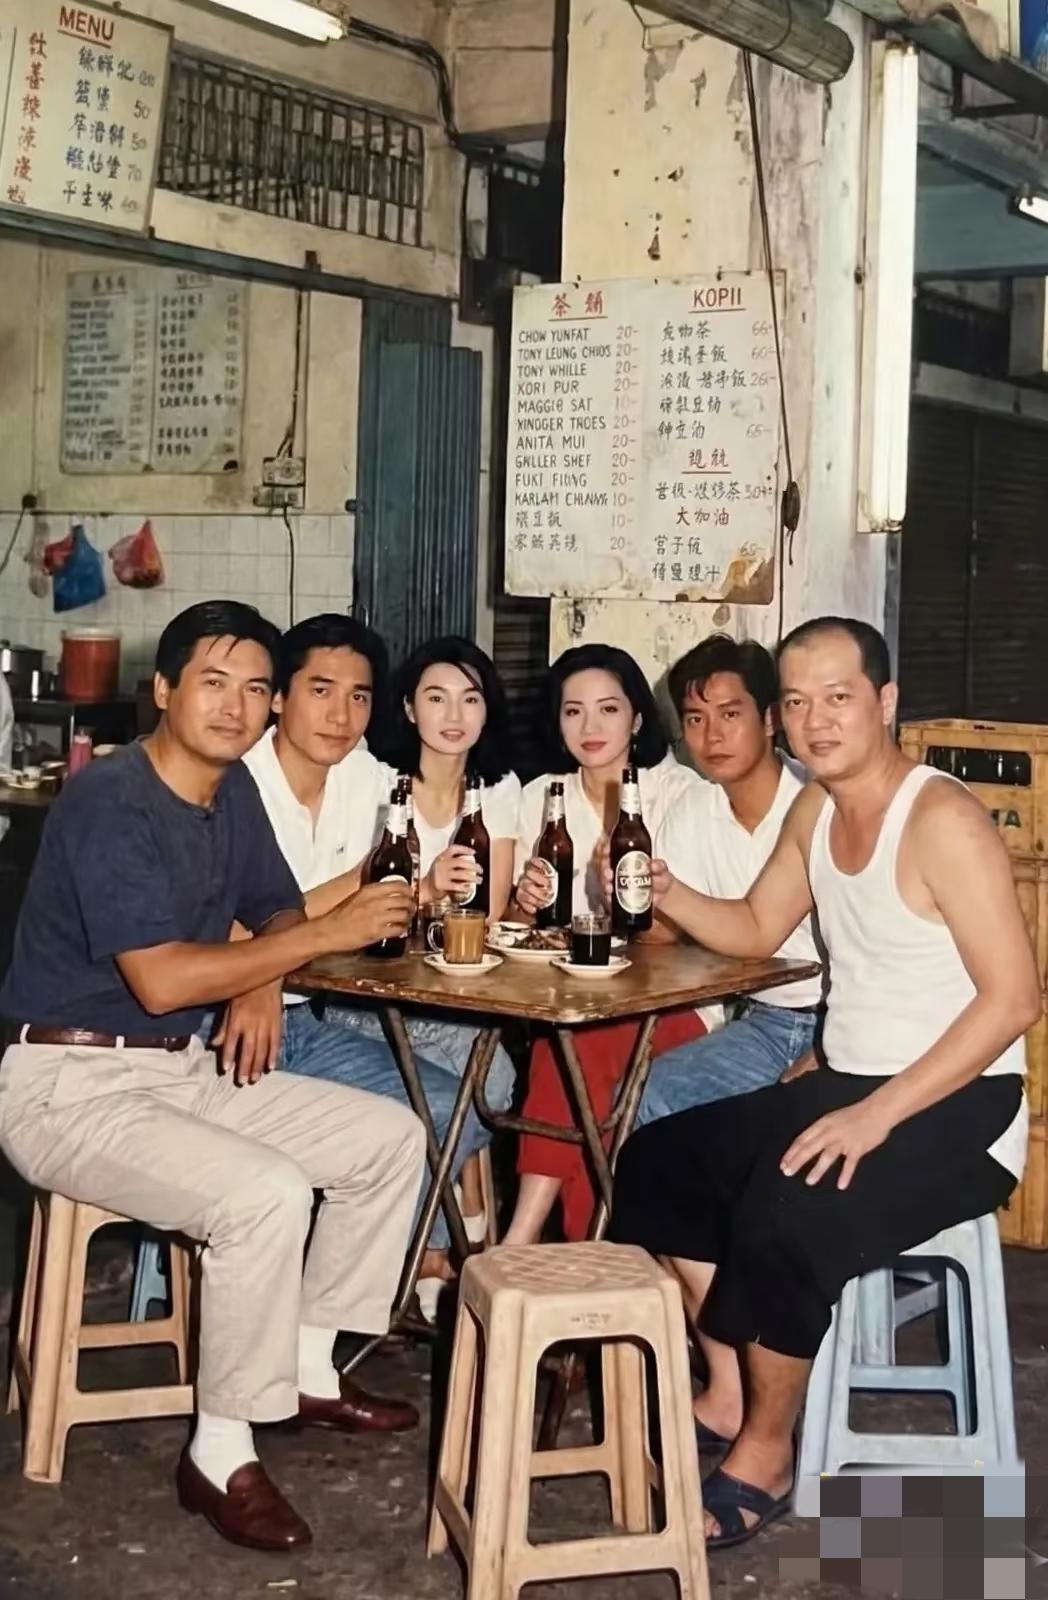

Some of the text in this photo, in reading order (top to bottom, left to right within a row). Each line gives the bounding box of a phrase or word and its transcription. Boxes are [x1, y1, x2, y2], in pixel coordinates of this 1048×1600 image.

[59, 5, 115, 41] MENU
[133, 100, 151, 121] 50
[693, 287, 741, 308] KOPII
[518, 330, 547, 343] CHOW
[551, 328, 590, 342] YUNFAT
[518, 349, 542, 361] TONY
[546, 346, 577, 361] LEUNG
[517, 365, 544, 378] TONY
[517, 382, 545, 395] KORI
[554, 380, 579, 394] PUR
[571, 398, 592, 412] SAT
[516, 435, 553, 450] ANITA
[562, 435, 585, 449] MUI
[676, 507, 730, 526] 大加油
